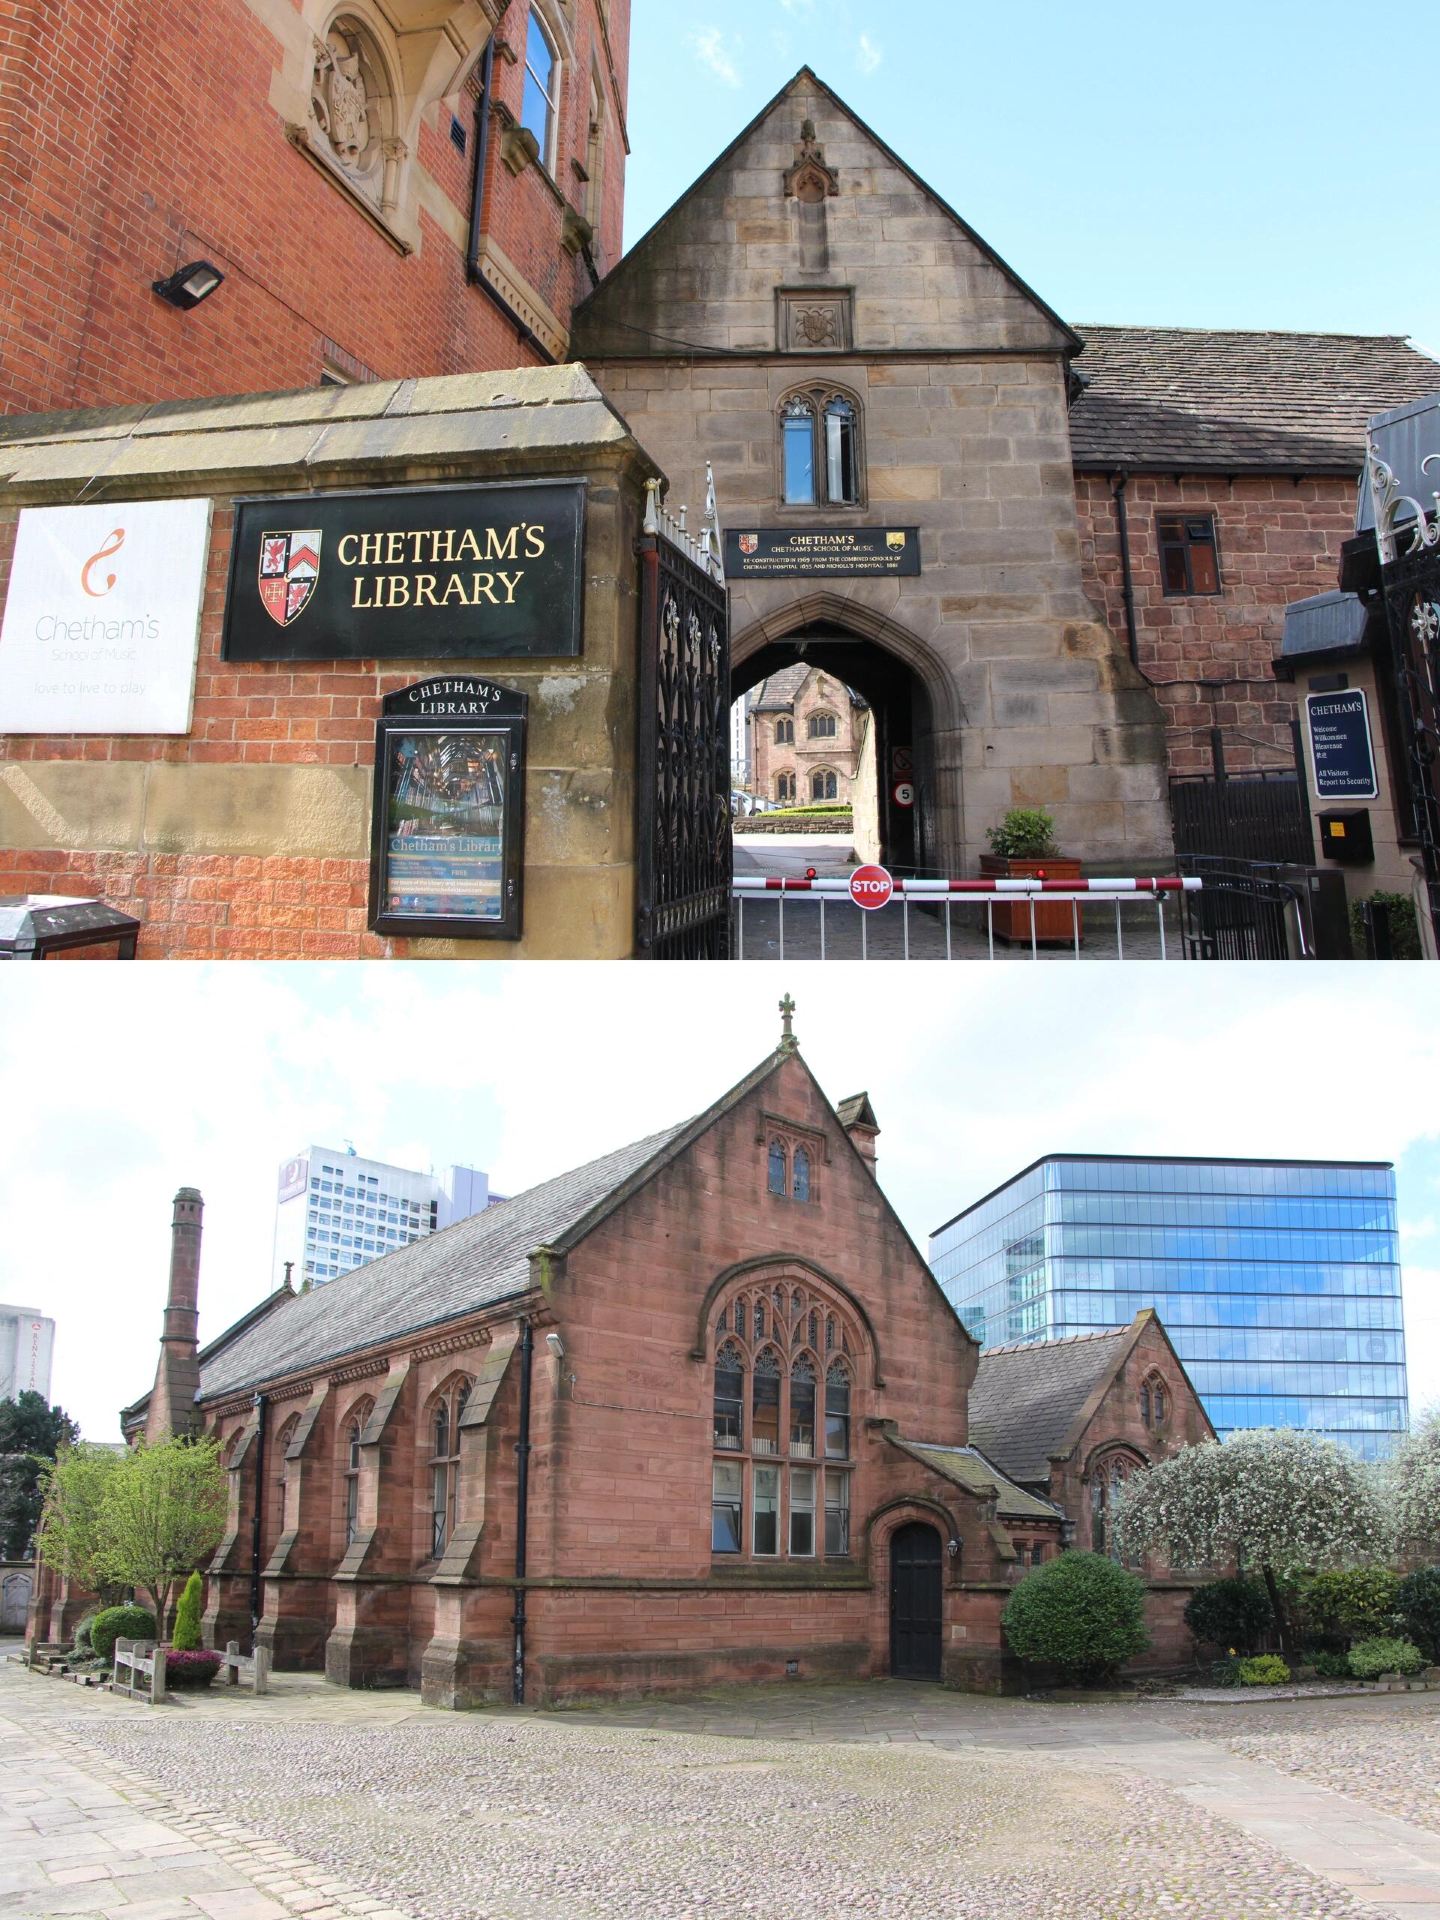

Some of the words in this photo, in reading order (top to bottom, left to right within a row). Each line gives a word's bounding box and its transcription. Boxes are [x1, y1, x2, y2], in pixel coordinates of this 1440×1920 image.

[337, 521, 547, 566] CHETHAM'S
[790, 536, 855, 545] CHETHAM'S
[352, 570, 526, 609] LIBRARY
[35, 614, 160, 642] Chetham's
[51, 648, 90, 662] School
[92, 648, 104, 660] of
[104, 648, 137, 660] Music
[34, 682, 60, 694] love
[63, 683, 76, 694] to
[79, 681, 100, 694] live
[104, 682, 117, 694] to
[120, 681, 146, 696] play
[408, 681, 502, 702] CHETHAM'S
[420, 702, 490, 714] LIBRARY
[1310, 701, 1362, 716] CHETHAM'S
[1346, 777, 1371, 786] Security
[902, 789, 910, 800] 5
[392, 838, 456, 852] Chetham's
[459, 838, 504, 856] Library
[852, 880, 889, 892] STOP
